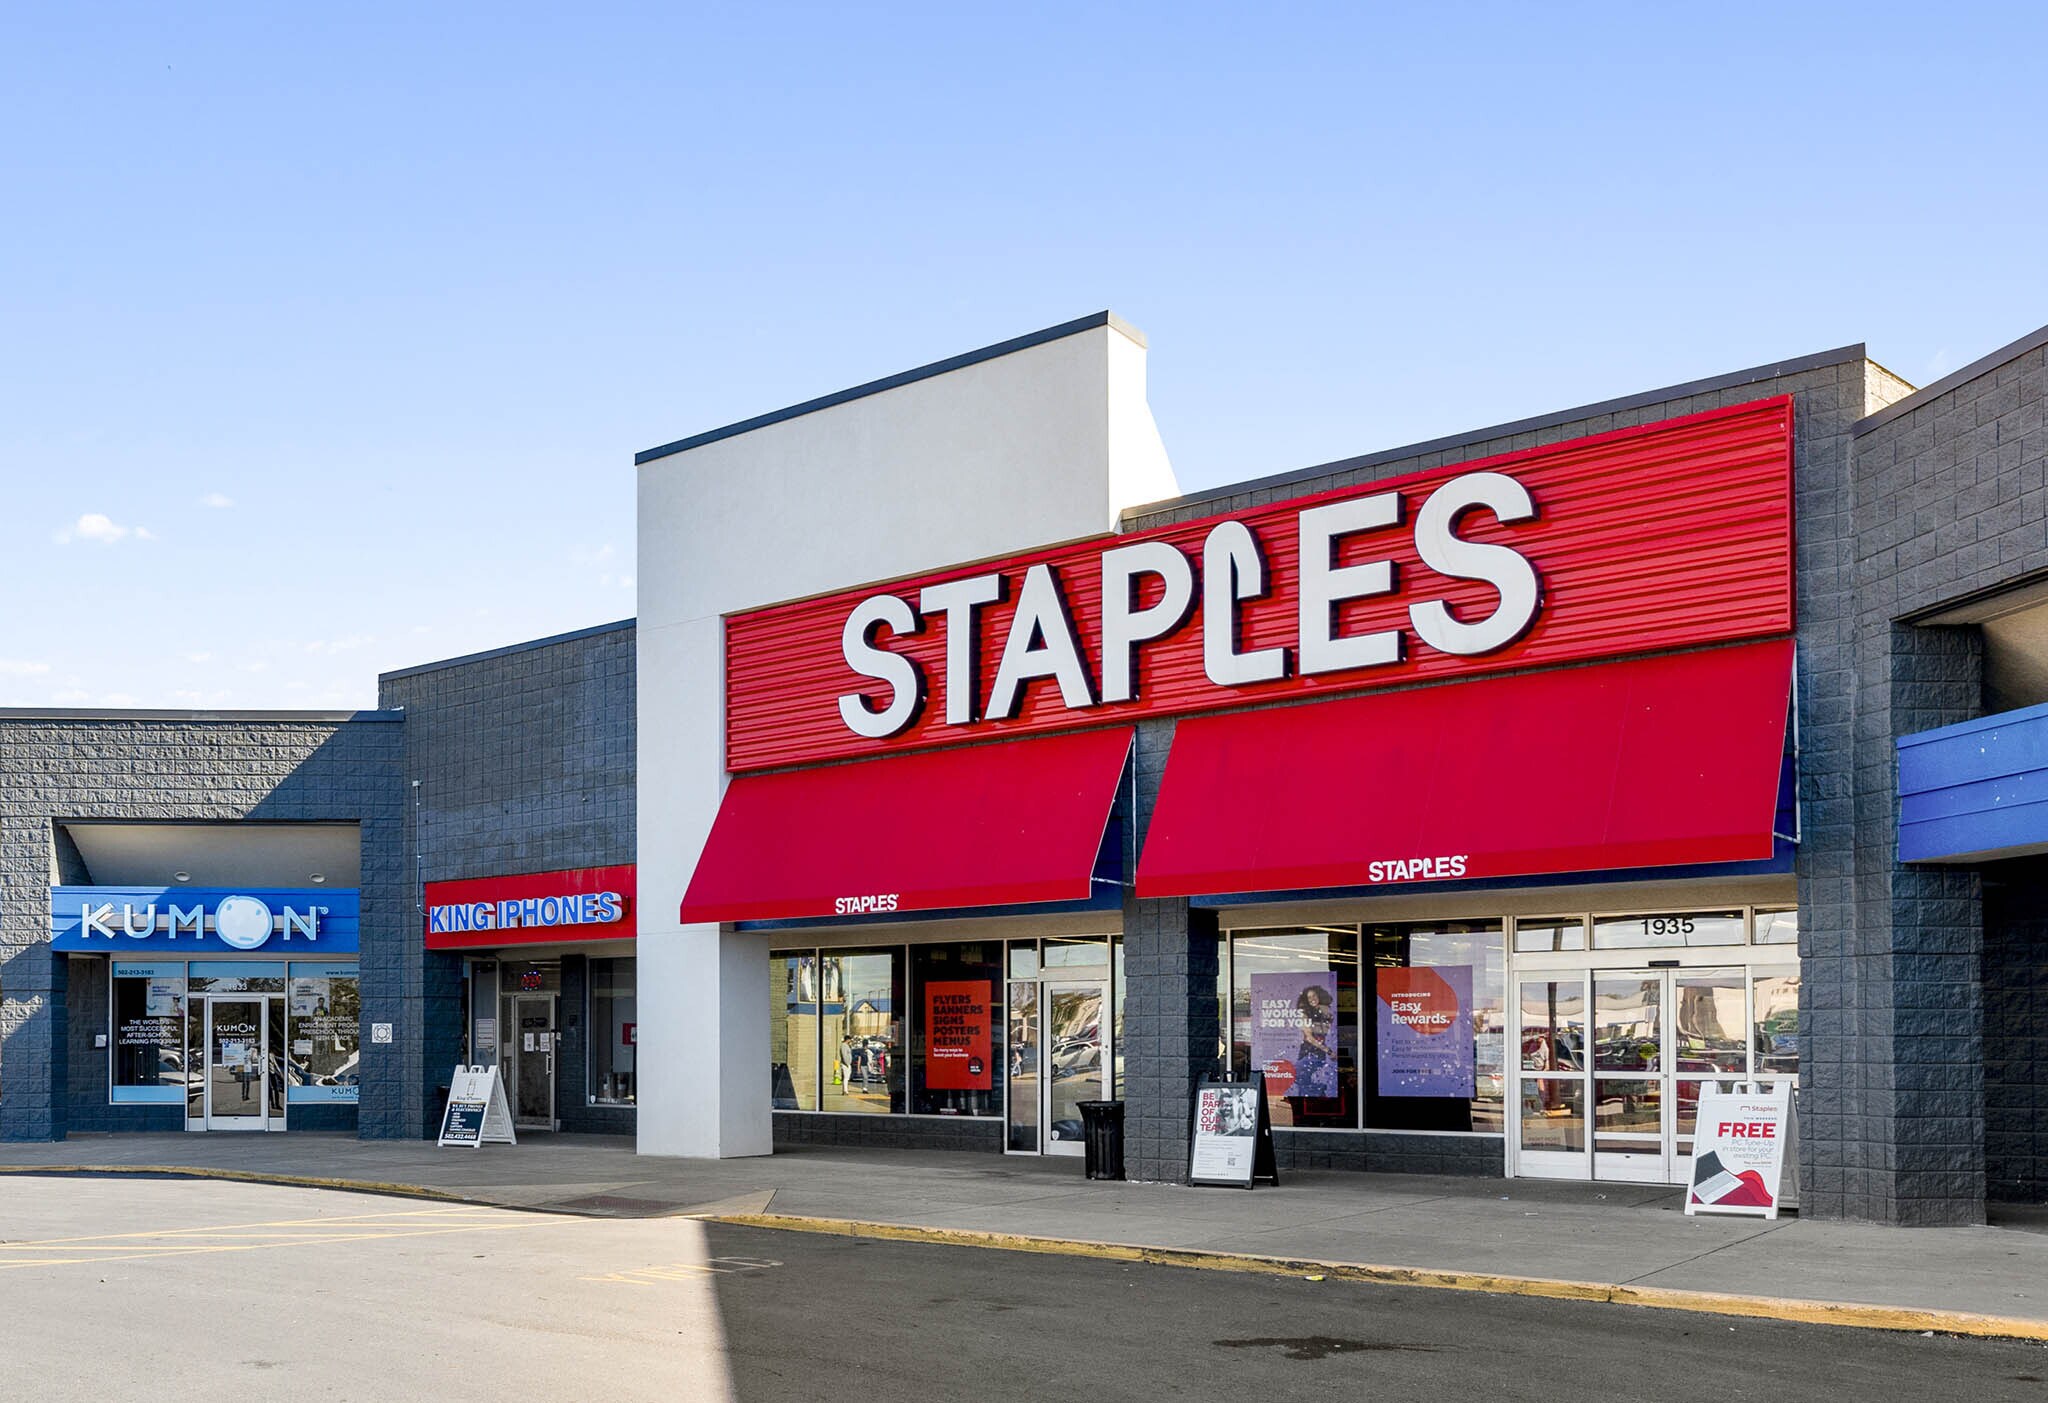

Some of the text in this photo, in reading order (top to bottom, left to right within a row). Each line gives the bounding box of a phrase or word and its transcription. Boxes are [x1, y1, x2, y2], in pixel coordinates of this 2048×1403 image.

[838, 472, 1540, 738] STAPLES
[1369, 855, 1466, 882] STAPLES
[835, 895, 897, 914] STAPLES
[429, 891, 622, 933] KING IPHONES
[81, 894, 317, 950] KUMON
[1640, 918, 1695, 935] 1935
[933, 994, 972, 1005] FLYERS
[1261, 999, 1292, 1009] EASY
[933, 1005, 984, 1015] BANNERS
[1391, 1000, 1422, 1014] Easy
[1261, 1008, 1304, 1018] WORKS
[933, 1015, 965, 1026] SIGNS
[1261, 1018, 1315, 1028] FOR YOU.
[1391, 1013, 1451, 1025] Rewards.
[216, 1022, 257, 1033] KUMON
[933, 1026, 981, 1036] POSTERS
[933, 1036, 971, 1046] MENUS
[1203, 1092, 1215, 1101] BE
[1201, 1108, 1215, 1116] OF
[1200, 1116, 1221, 1124] OUR
[1717, 1122, 1777, 1138] FREE
